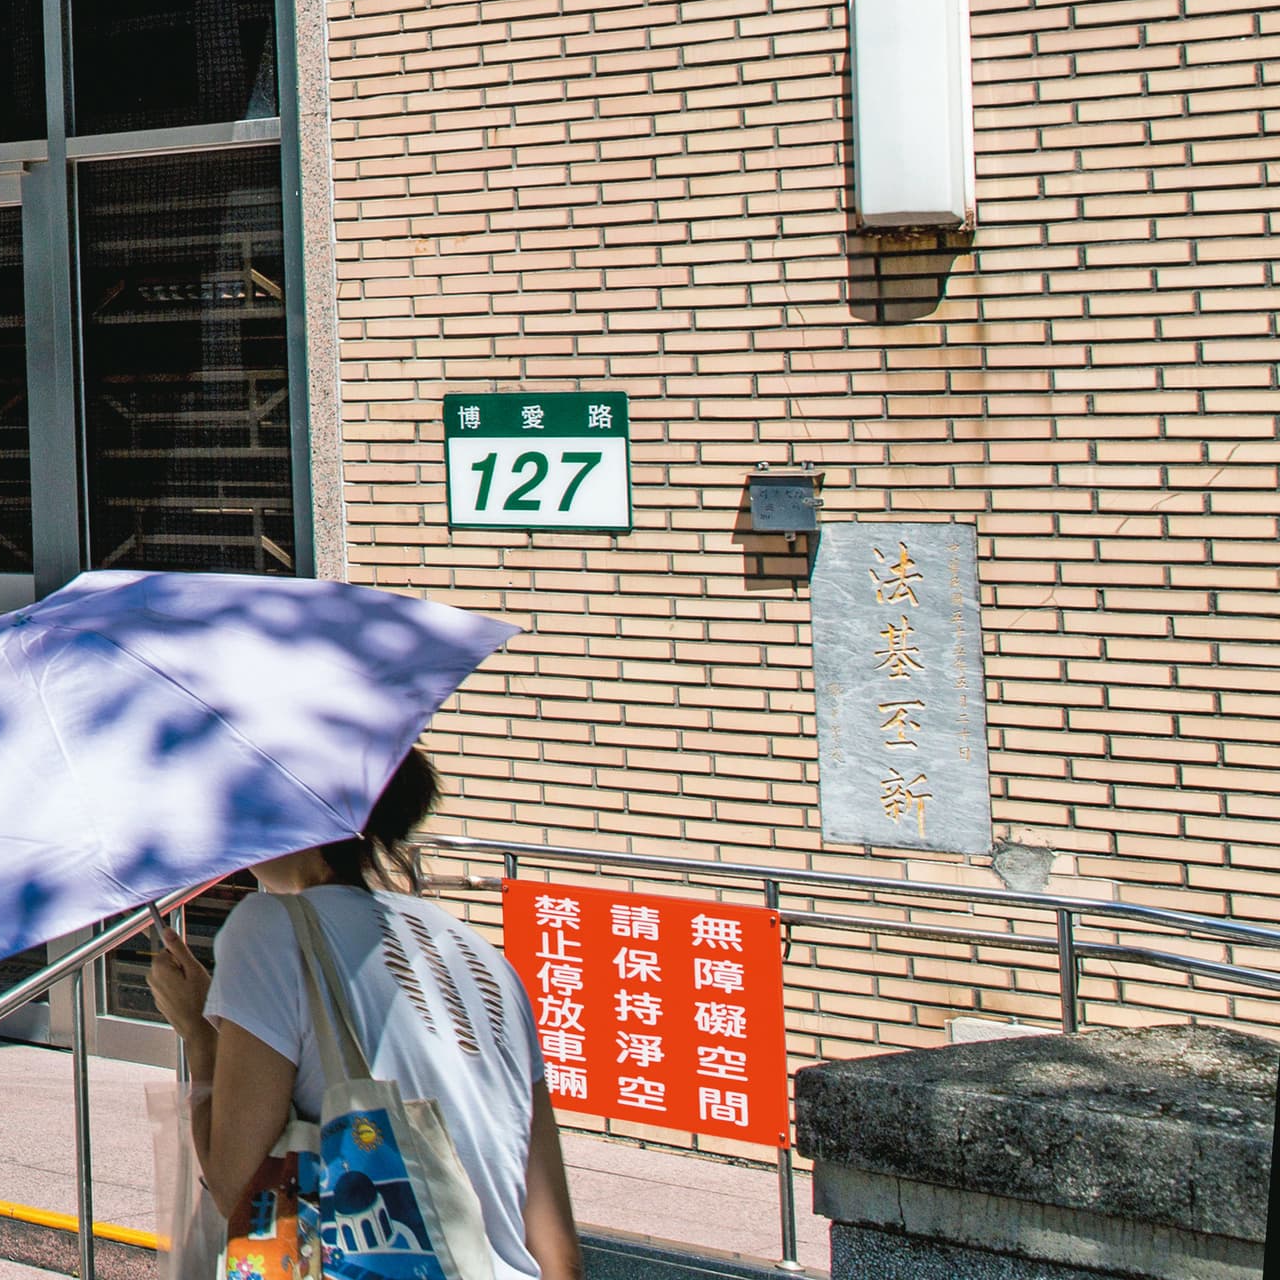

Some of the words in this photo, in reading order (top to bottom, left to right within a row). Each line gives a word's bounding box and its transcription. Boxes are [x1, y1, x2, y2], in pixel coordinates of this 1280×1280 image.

[457, 404, 613, 430] 博愛路
[471, 451, 603, 511] 127
[534, 894, 588, 1100] 禁止停放車輛
[610, 904, 667, 1112] 請保持淨空
[690, 913, 749, 1127] 無障礙空間
